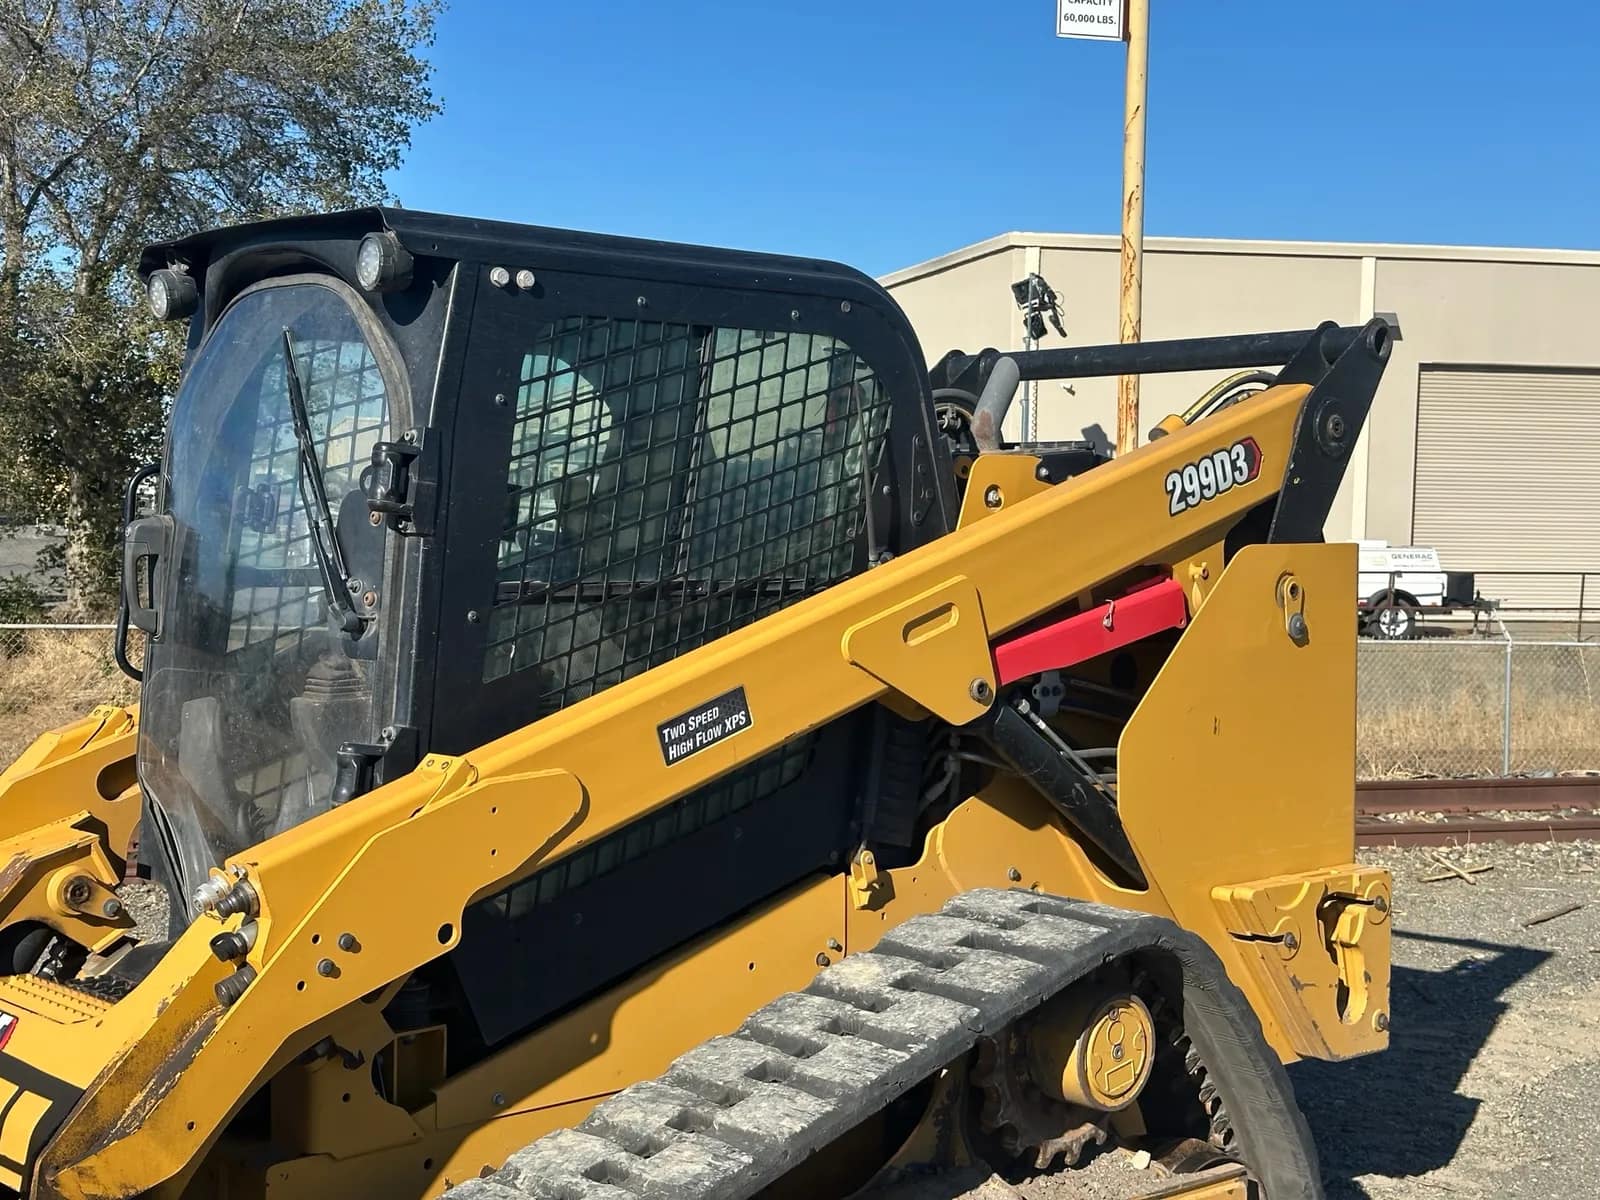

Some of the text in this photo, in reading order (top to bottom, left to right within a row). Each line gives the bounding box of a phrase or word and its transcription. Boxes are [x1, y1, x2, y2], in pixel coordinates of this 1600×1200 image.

[1064, 13, 1116, 24] 60,000 LBS.
[1166, 444, 1249, 514] 299D3
[724, 710, 746, 733] XPS
